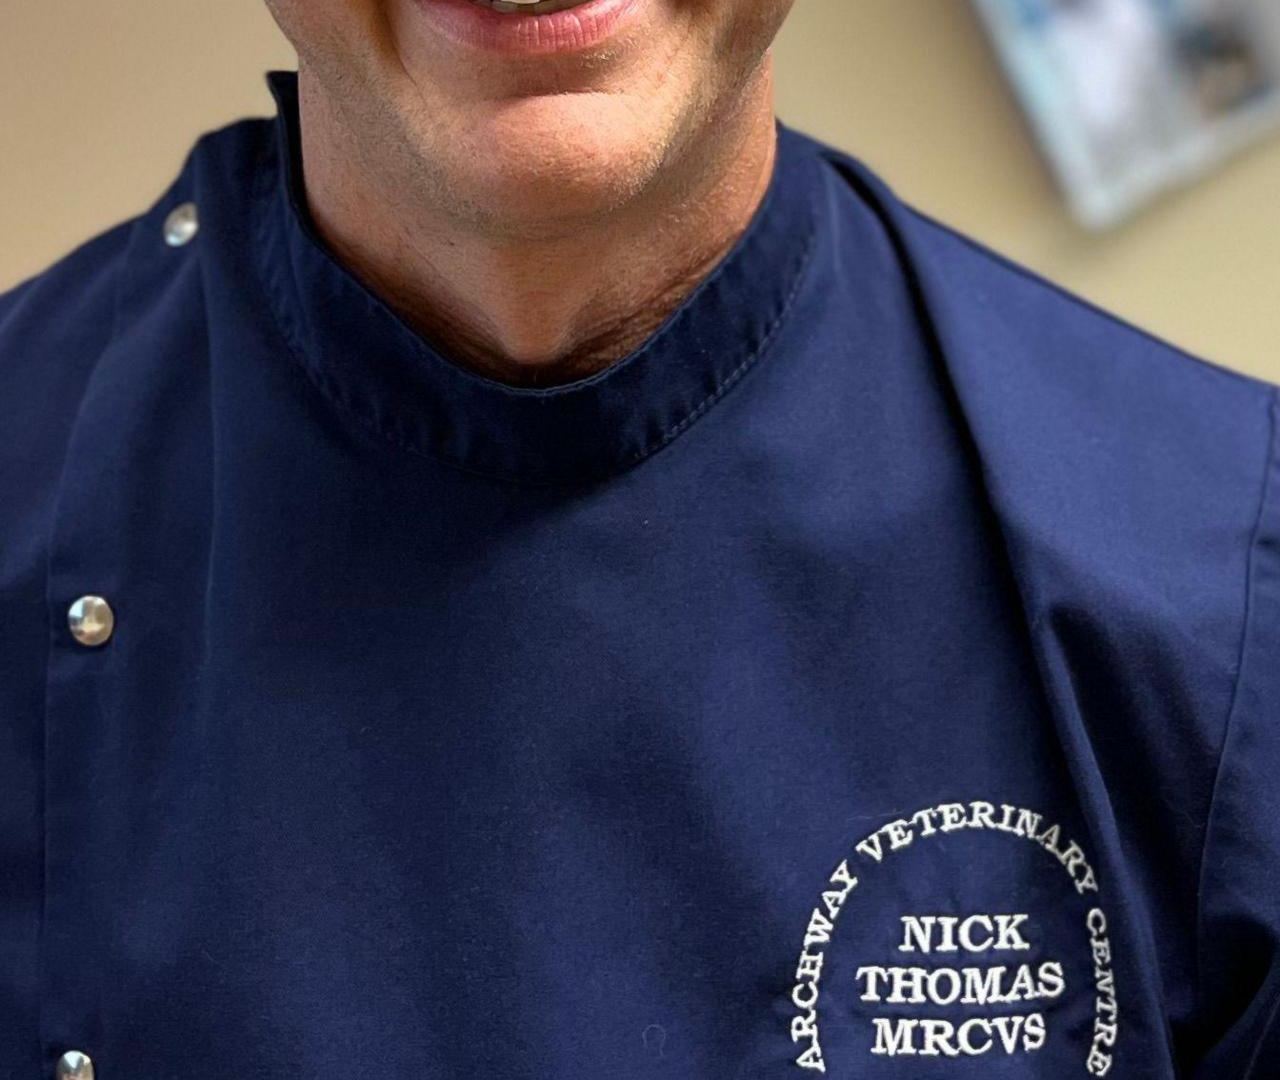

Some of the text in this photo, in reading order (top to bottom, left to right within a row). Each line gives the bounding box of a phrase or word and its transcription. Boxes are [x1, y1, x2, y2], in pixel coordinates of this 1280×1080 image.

[791, 800, 1118, 1077] ARCHWAY VETERINARY CENTRE
[898, 914, 1030, 954] NICK
[855, 962, 1065, 1006] THOMAS
[870, 1013, 1046, 1057] MRCVS
